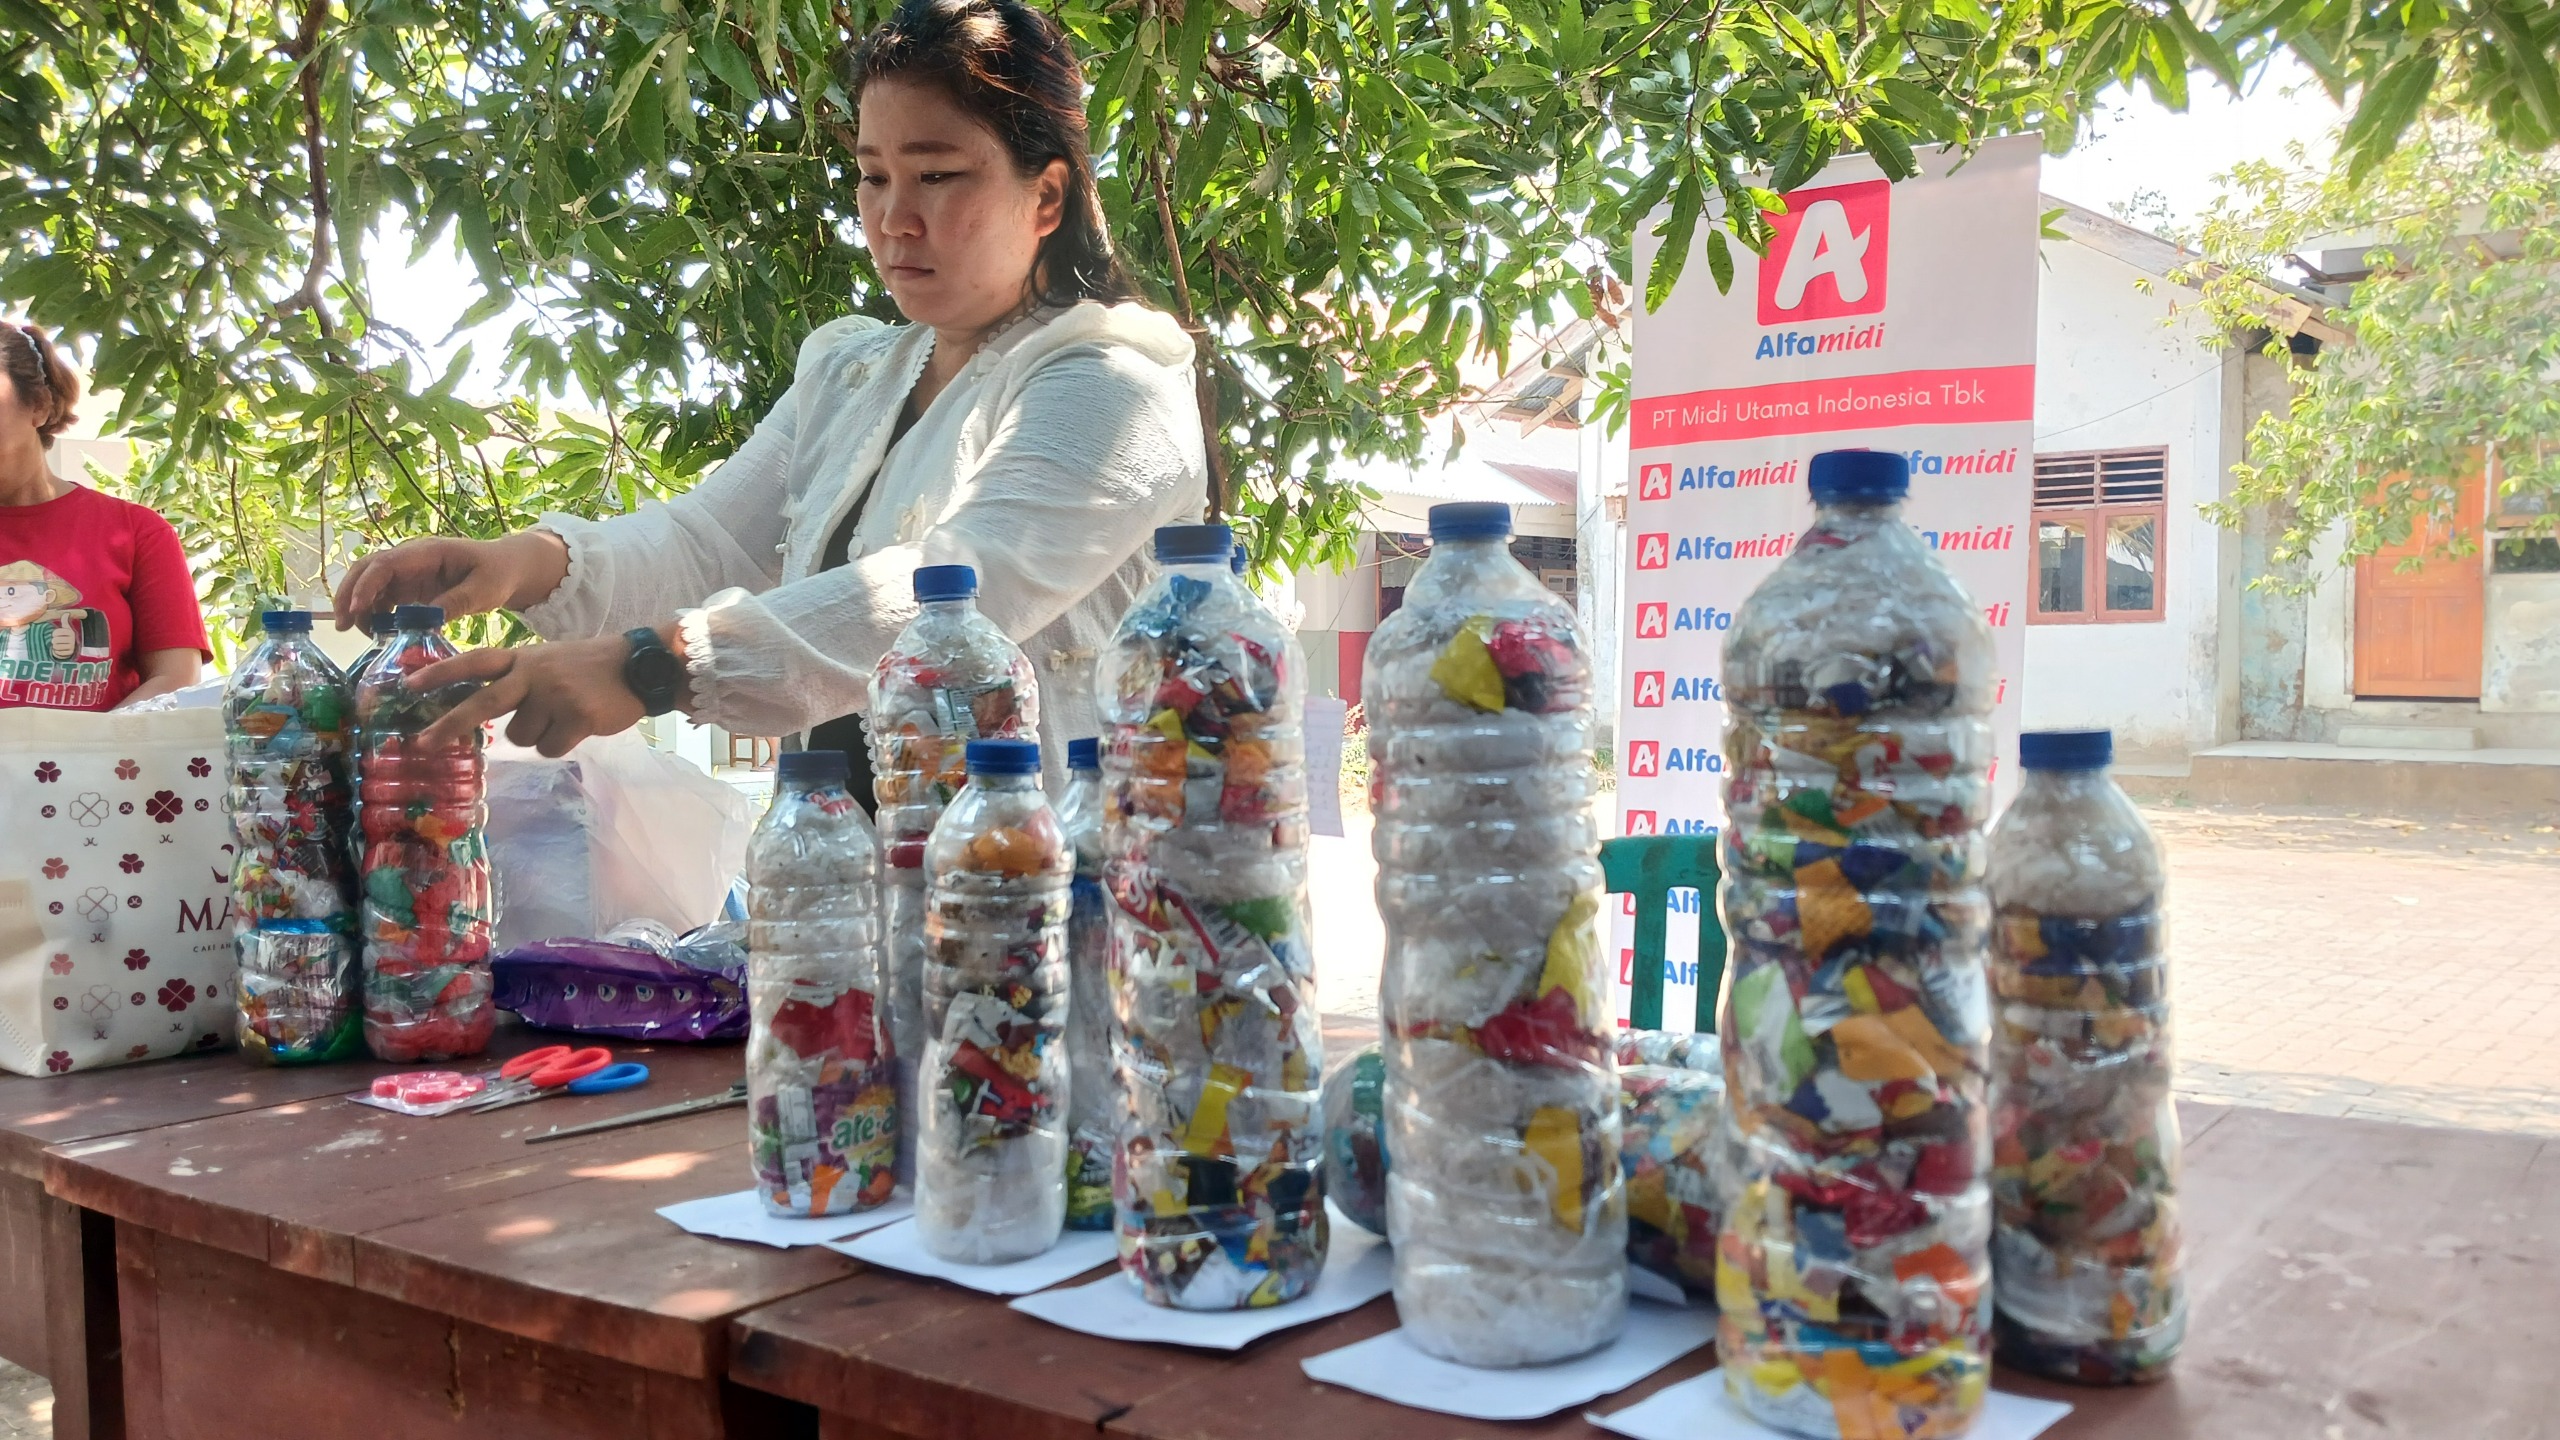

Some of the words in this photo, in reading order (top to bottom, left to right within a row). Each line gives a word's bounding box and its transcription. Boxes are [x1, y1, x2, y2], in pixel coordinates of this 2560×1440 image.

[1755, 322, 1885, 360] Alfamidi
[1652, 409, 1676, 430] PT
[1682, 401, 1727, 427] Midi
[1736, 399, 1810, 422] Utama
[1817, 387, 1932, 415] Indonesia
[1940, 379, 1986, 406] Tbk
[1679, 459, 1798, 491] Alfamidi
[1902, 447, 2018, 475] famidi
[1675, 532, 1796, 562] Alfamidi
[1914, 524, 2015, 551] amidi
[1674, 607, 1732, 631] Alfa
[1666, 747, 1722, 773] Alfa
[220, 942, 231, 951] AN
